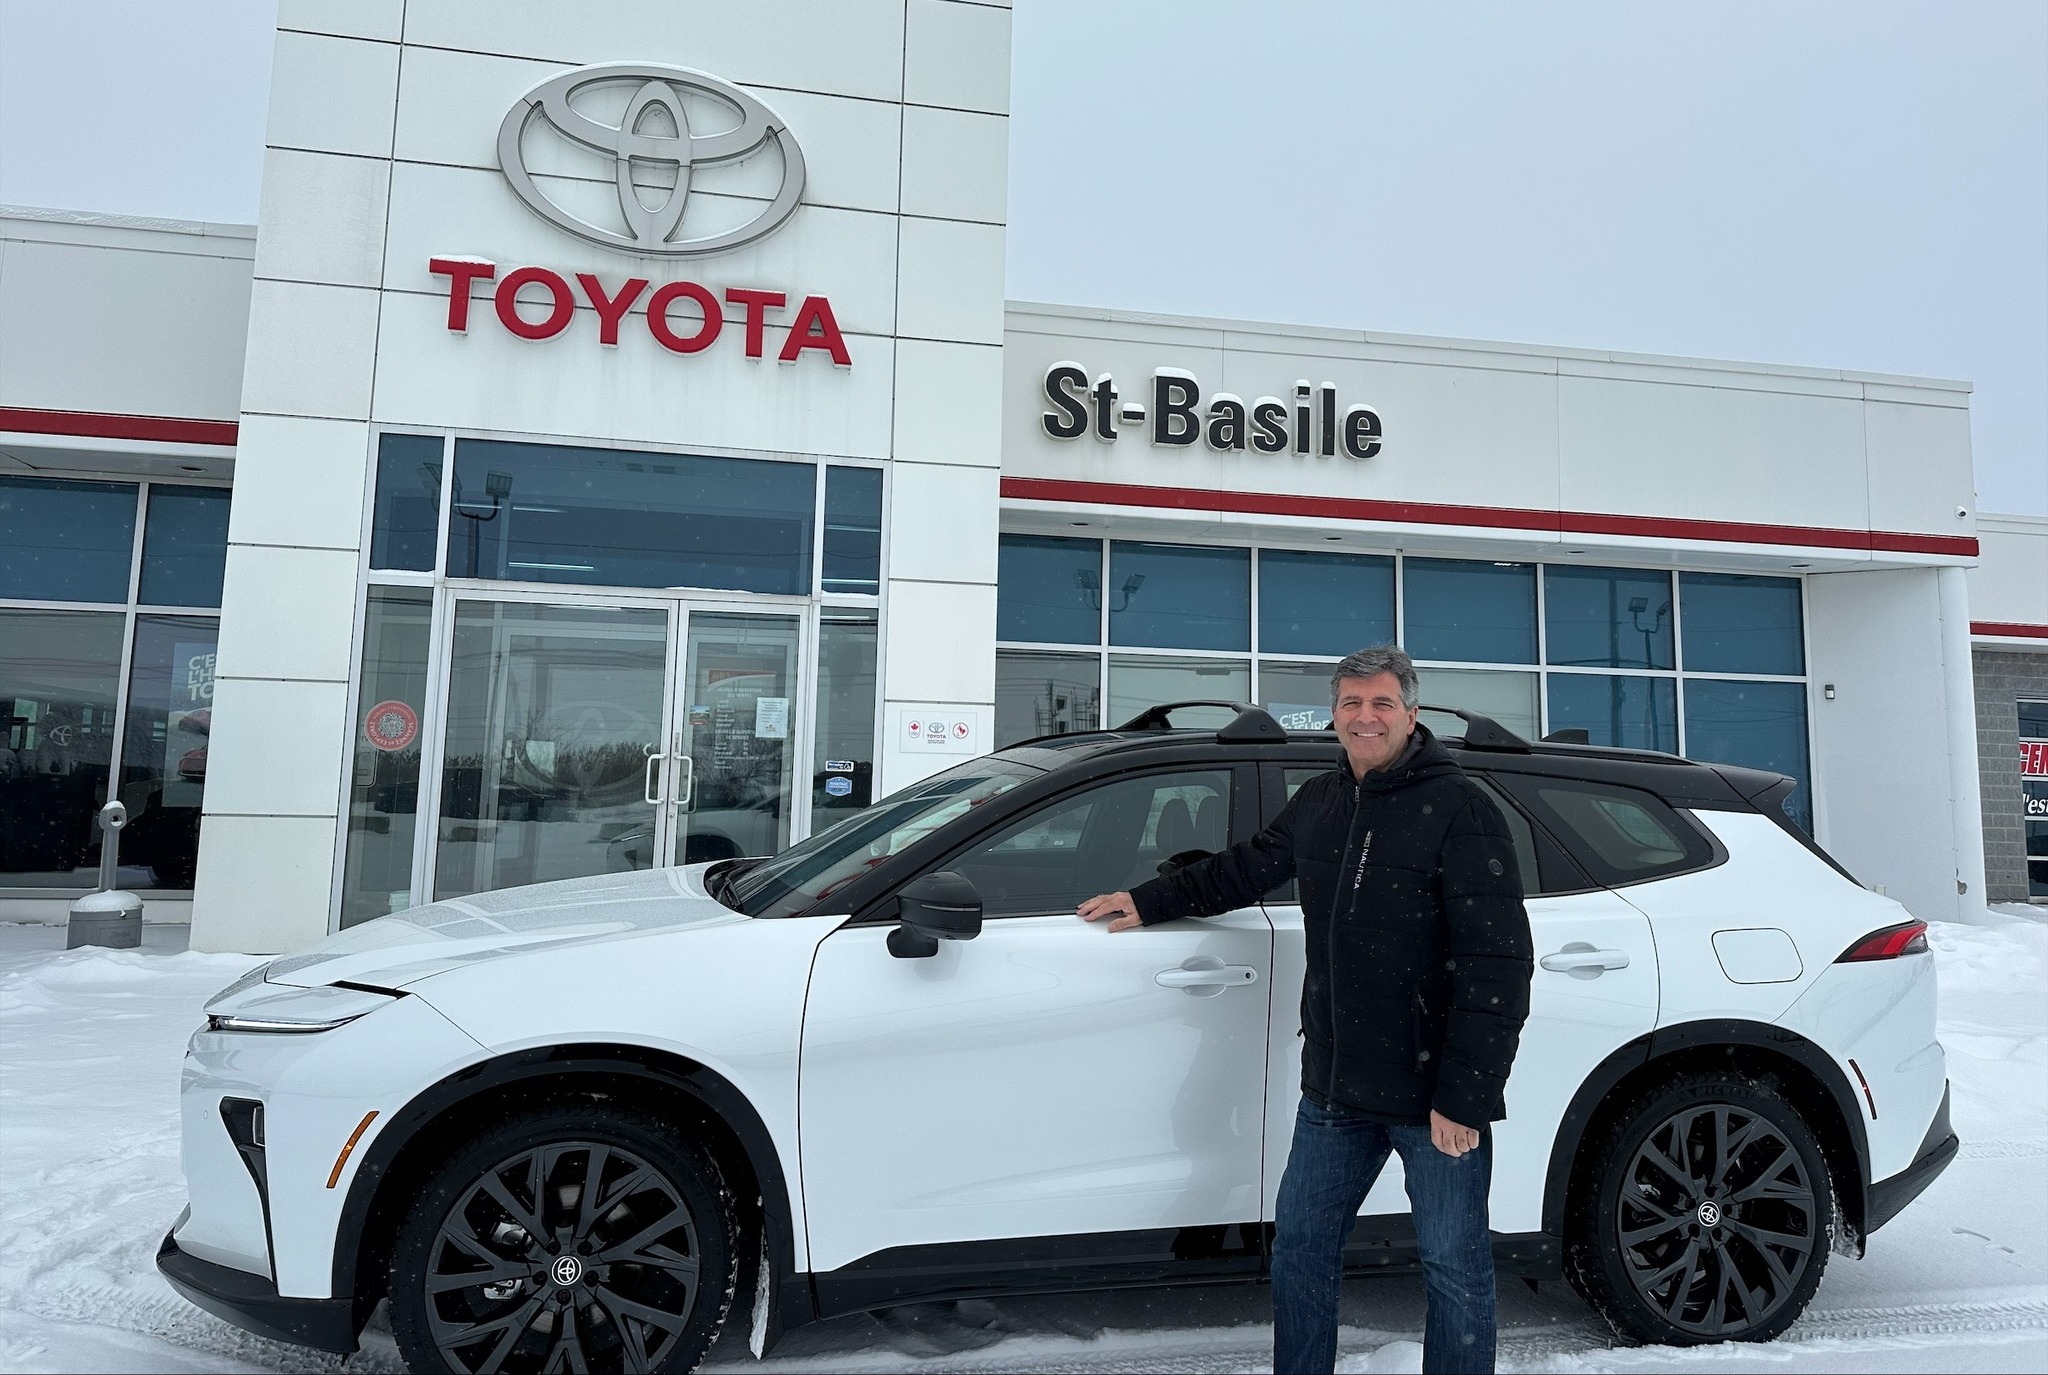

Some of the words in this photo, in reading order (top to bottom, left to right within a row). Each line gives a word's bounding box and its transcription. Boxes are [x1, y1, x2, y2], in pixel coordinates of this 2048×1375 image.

[429, 256, 853, 369] TOYOTA
[1042, 362, 1383, 460] St-Basile
[1279, 710, 1314, 728] C'EST
[1353, 848, 1369, 890] NAUTICA
